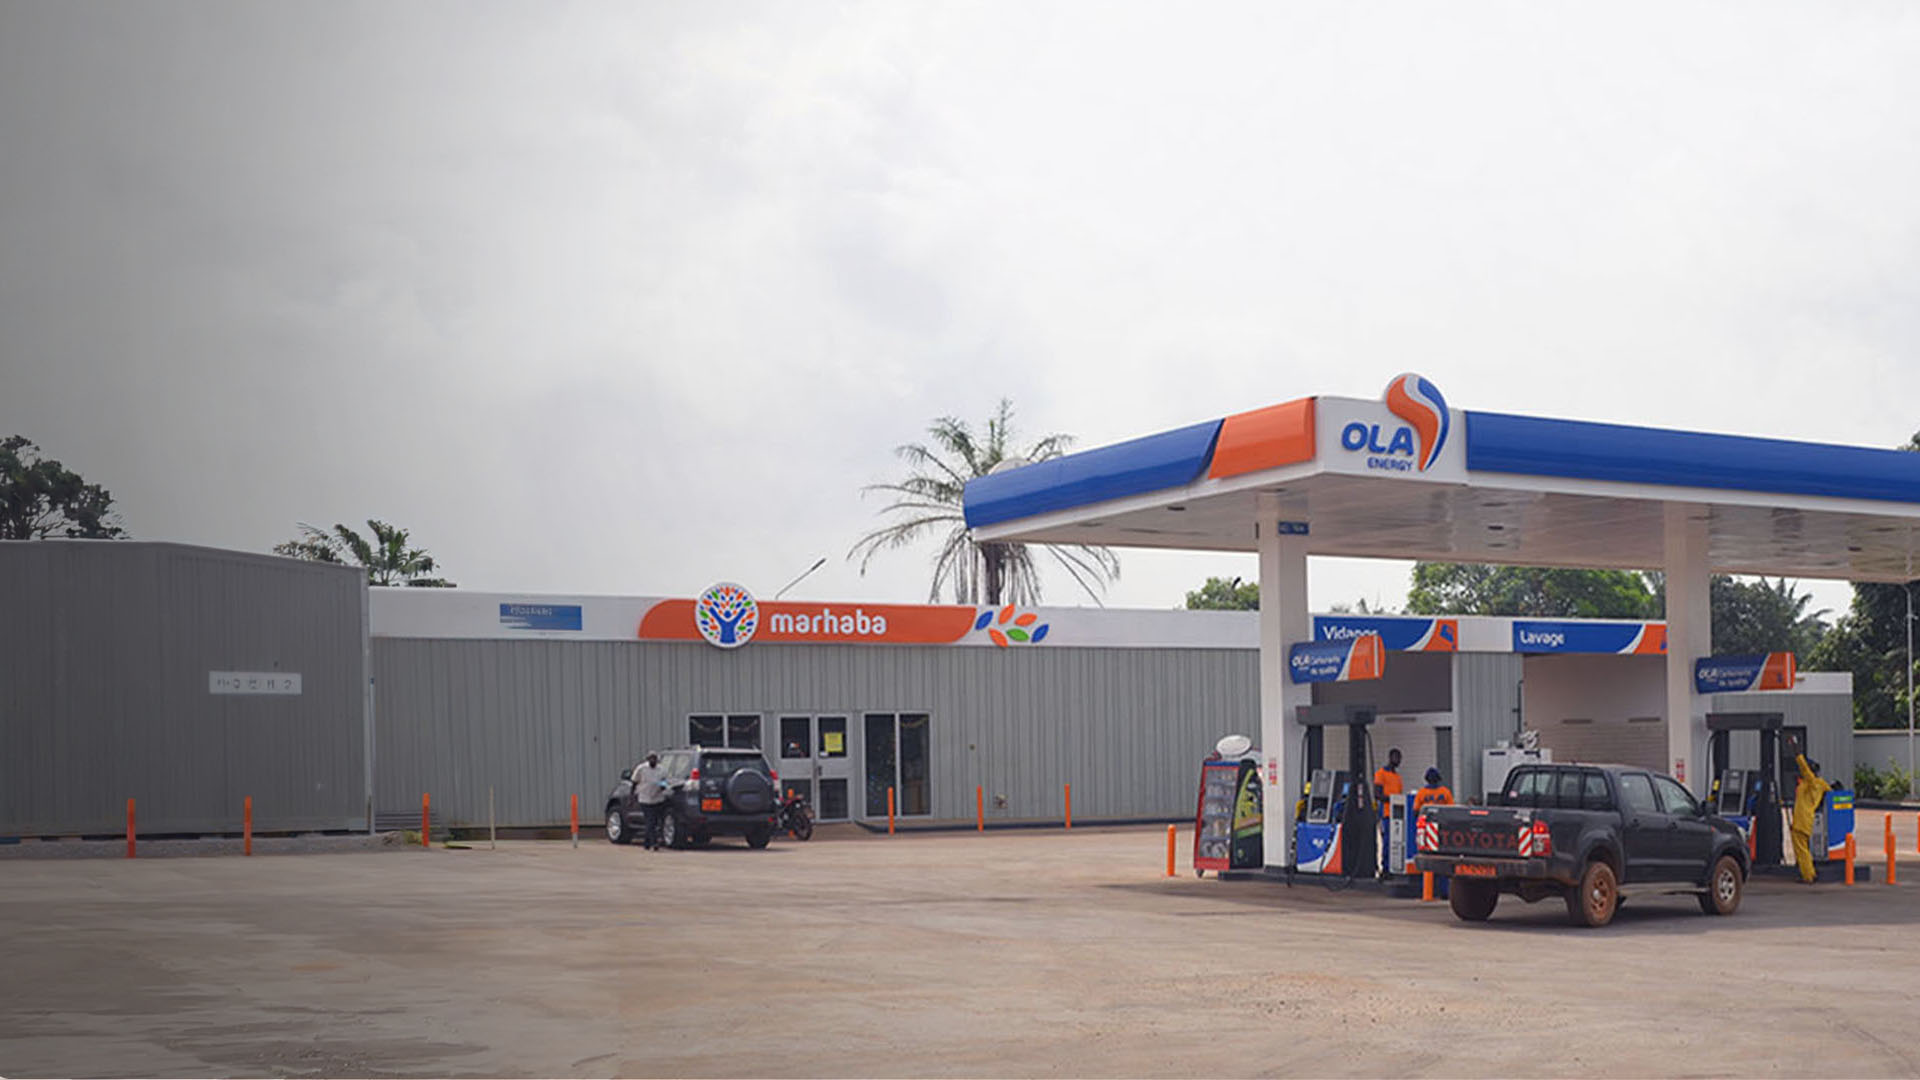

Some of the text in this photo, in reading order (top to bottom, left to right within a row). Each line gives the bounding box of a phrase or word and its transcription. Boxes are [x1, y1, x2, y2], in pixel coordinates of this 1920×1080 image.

[1342, 422, 1414, 456] OLA
[1367, 457, 1412, 471] ENERGY
[770, 608, 887, 635] marhaba
[1520, 630, 1565, 647] Lavage
[1442, 830, 1517, 849] TOYOTA
